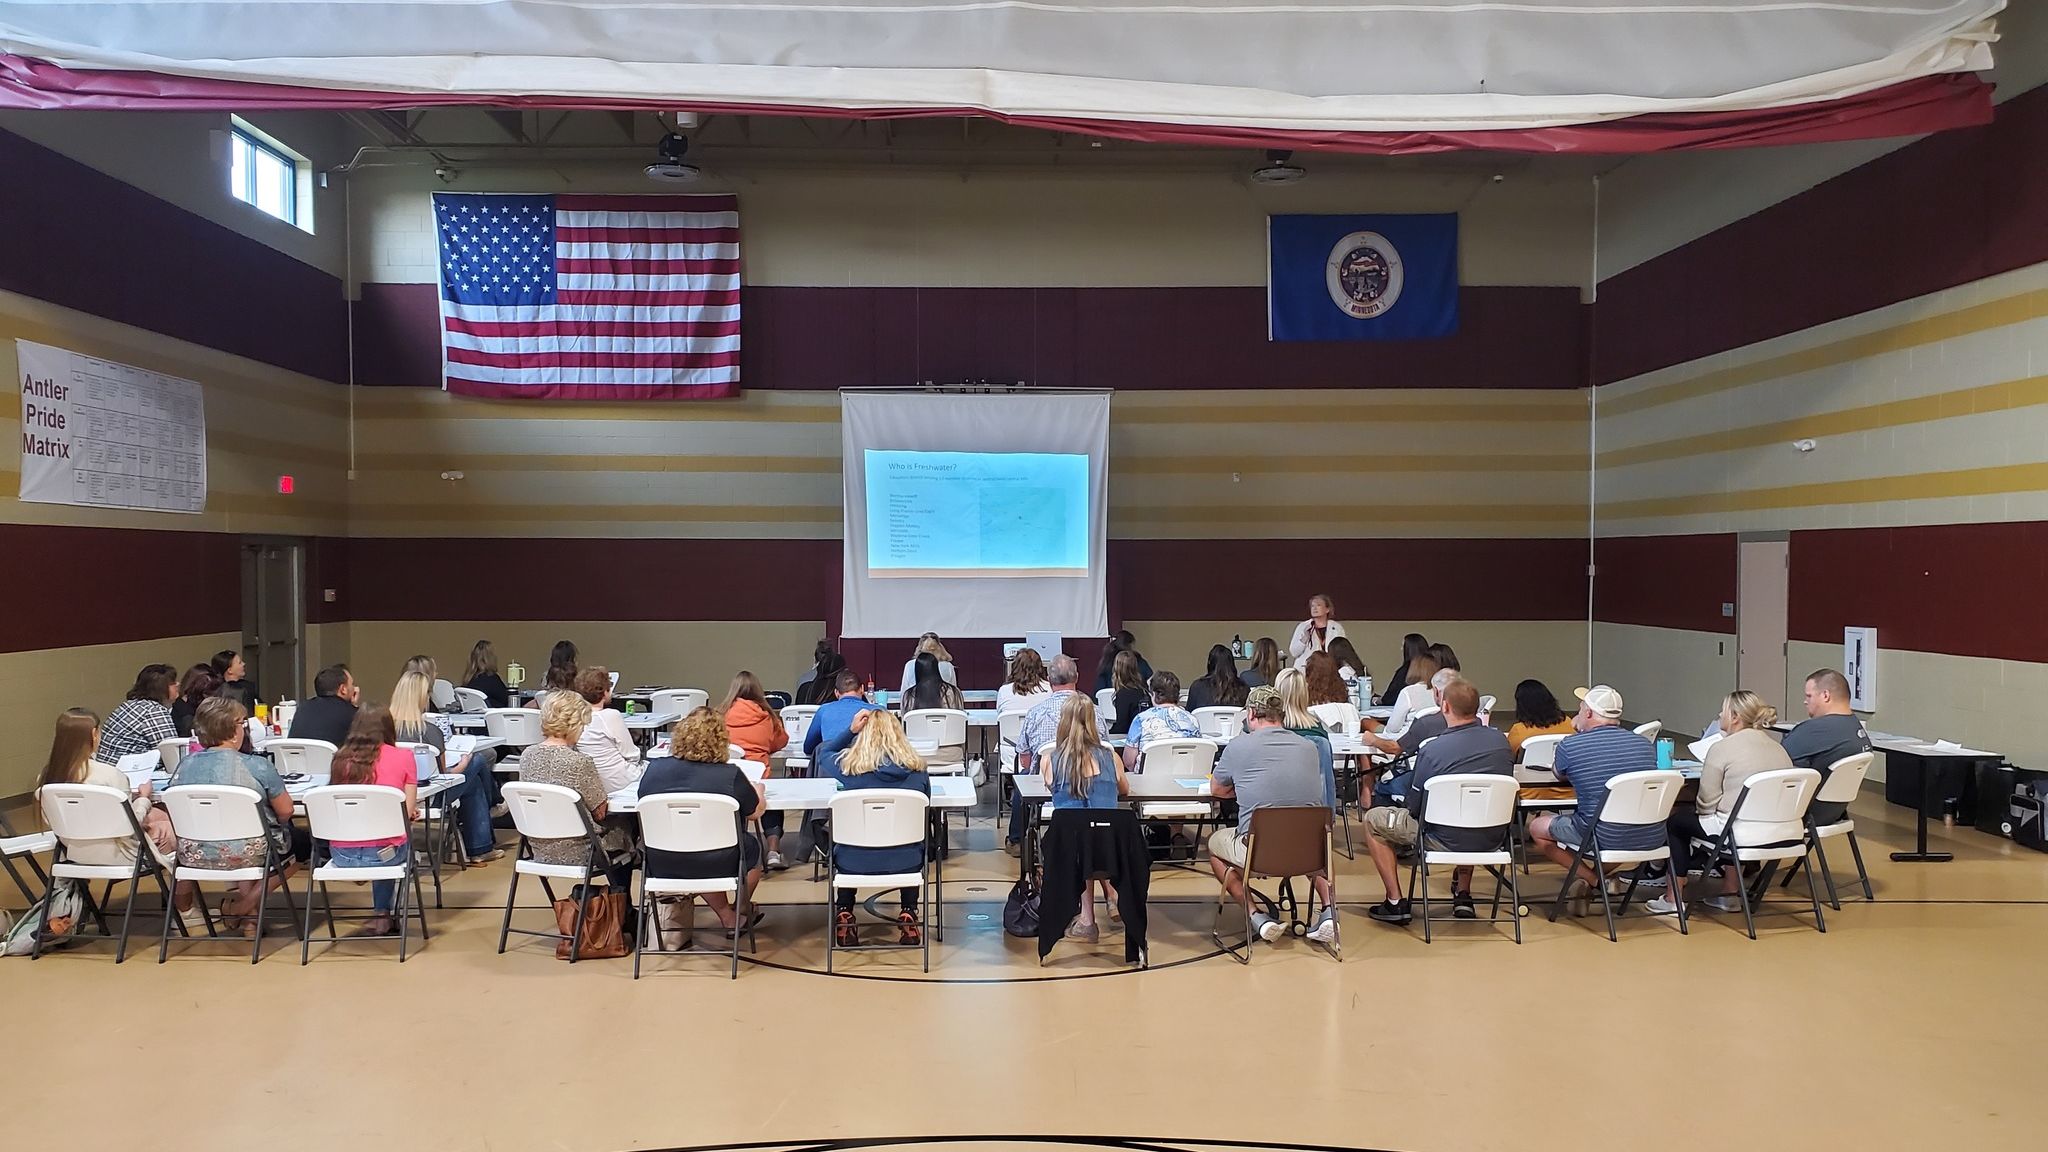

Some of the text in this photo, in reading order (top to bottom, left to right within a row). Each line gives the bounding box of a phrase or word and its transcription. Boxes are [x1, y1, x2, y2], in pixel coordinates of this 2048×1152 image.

[23, 374, 69, 401] Antler
[26, 403, 66, 429] Pride
[23, 432, 70, 459] Matrix
[914, 463, 957, 471] Freshwater?
